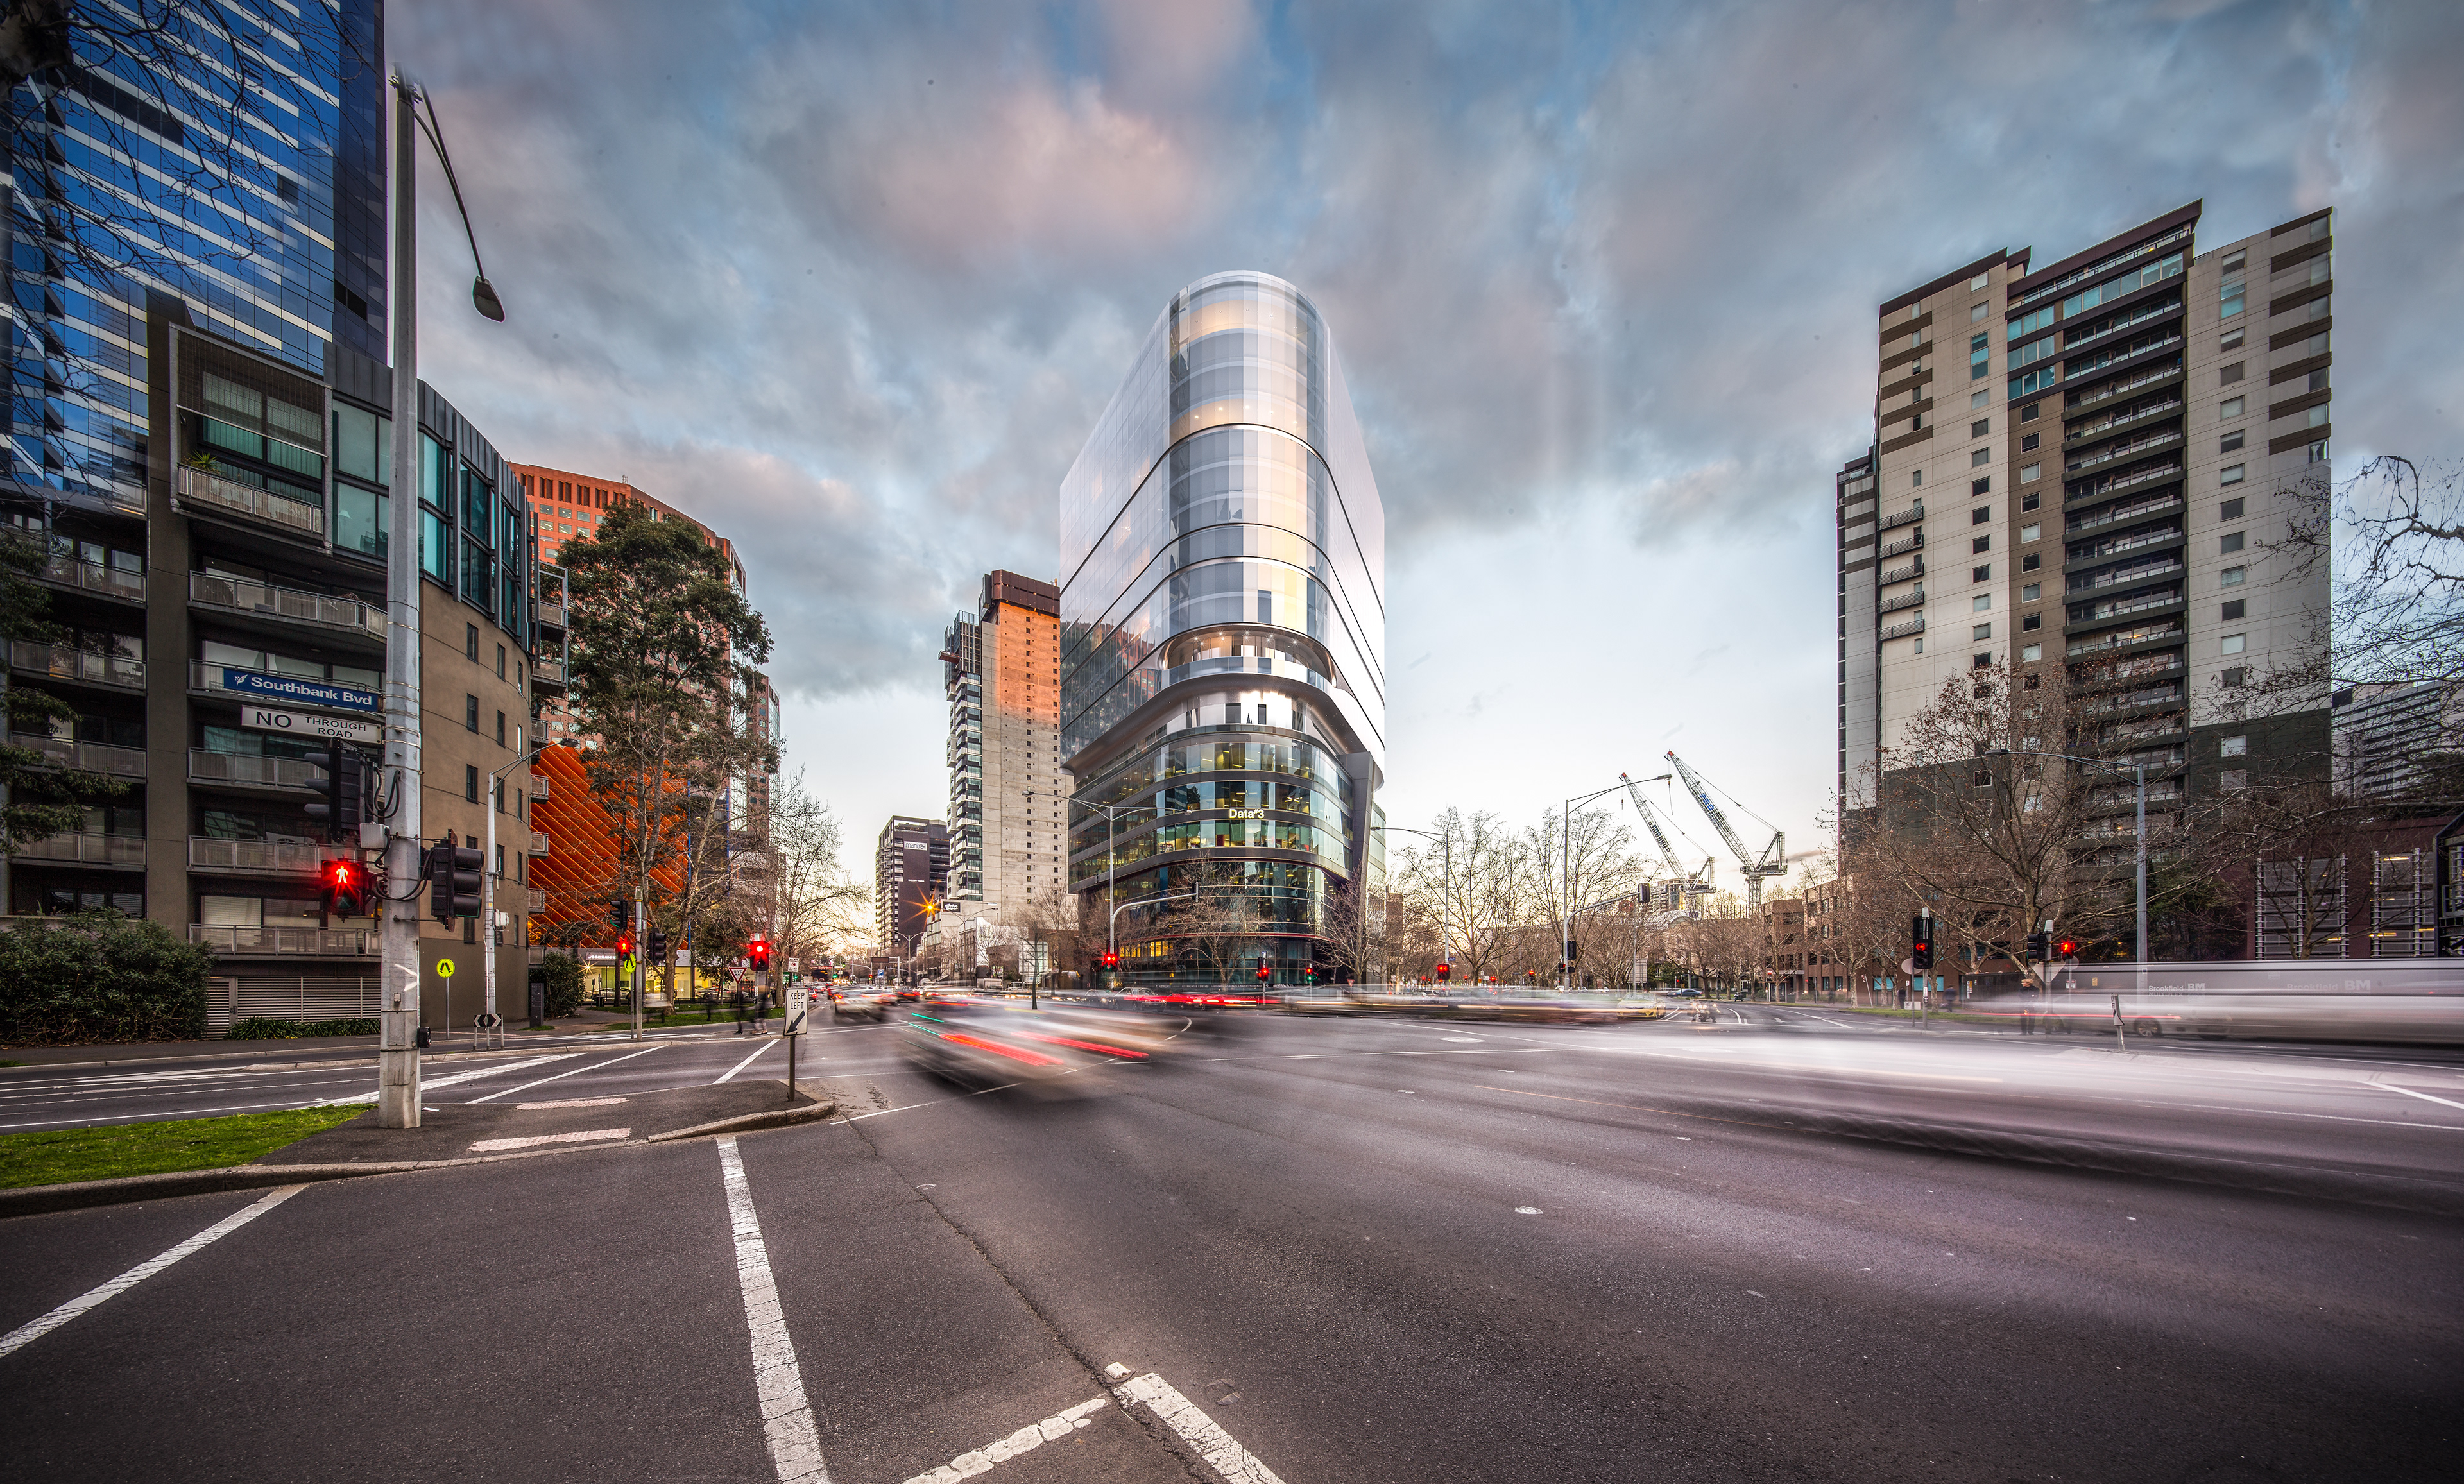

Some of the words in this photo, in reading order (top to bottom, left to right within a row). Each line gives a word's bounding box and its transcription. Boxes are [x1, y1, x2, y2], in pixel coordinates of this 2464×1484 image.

[251, 676, 338, 701] Southbank
[343, 692, 372, 706] Bvd
[256, 711, 292, 728] NO
[305, 716, 366, 731] THROUGH
[318, 727, 353, 738] ROAD
[1229, 808, 1265, 819] Data#3
[2345, 980, 2371, 991] BM
